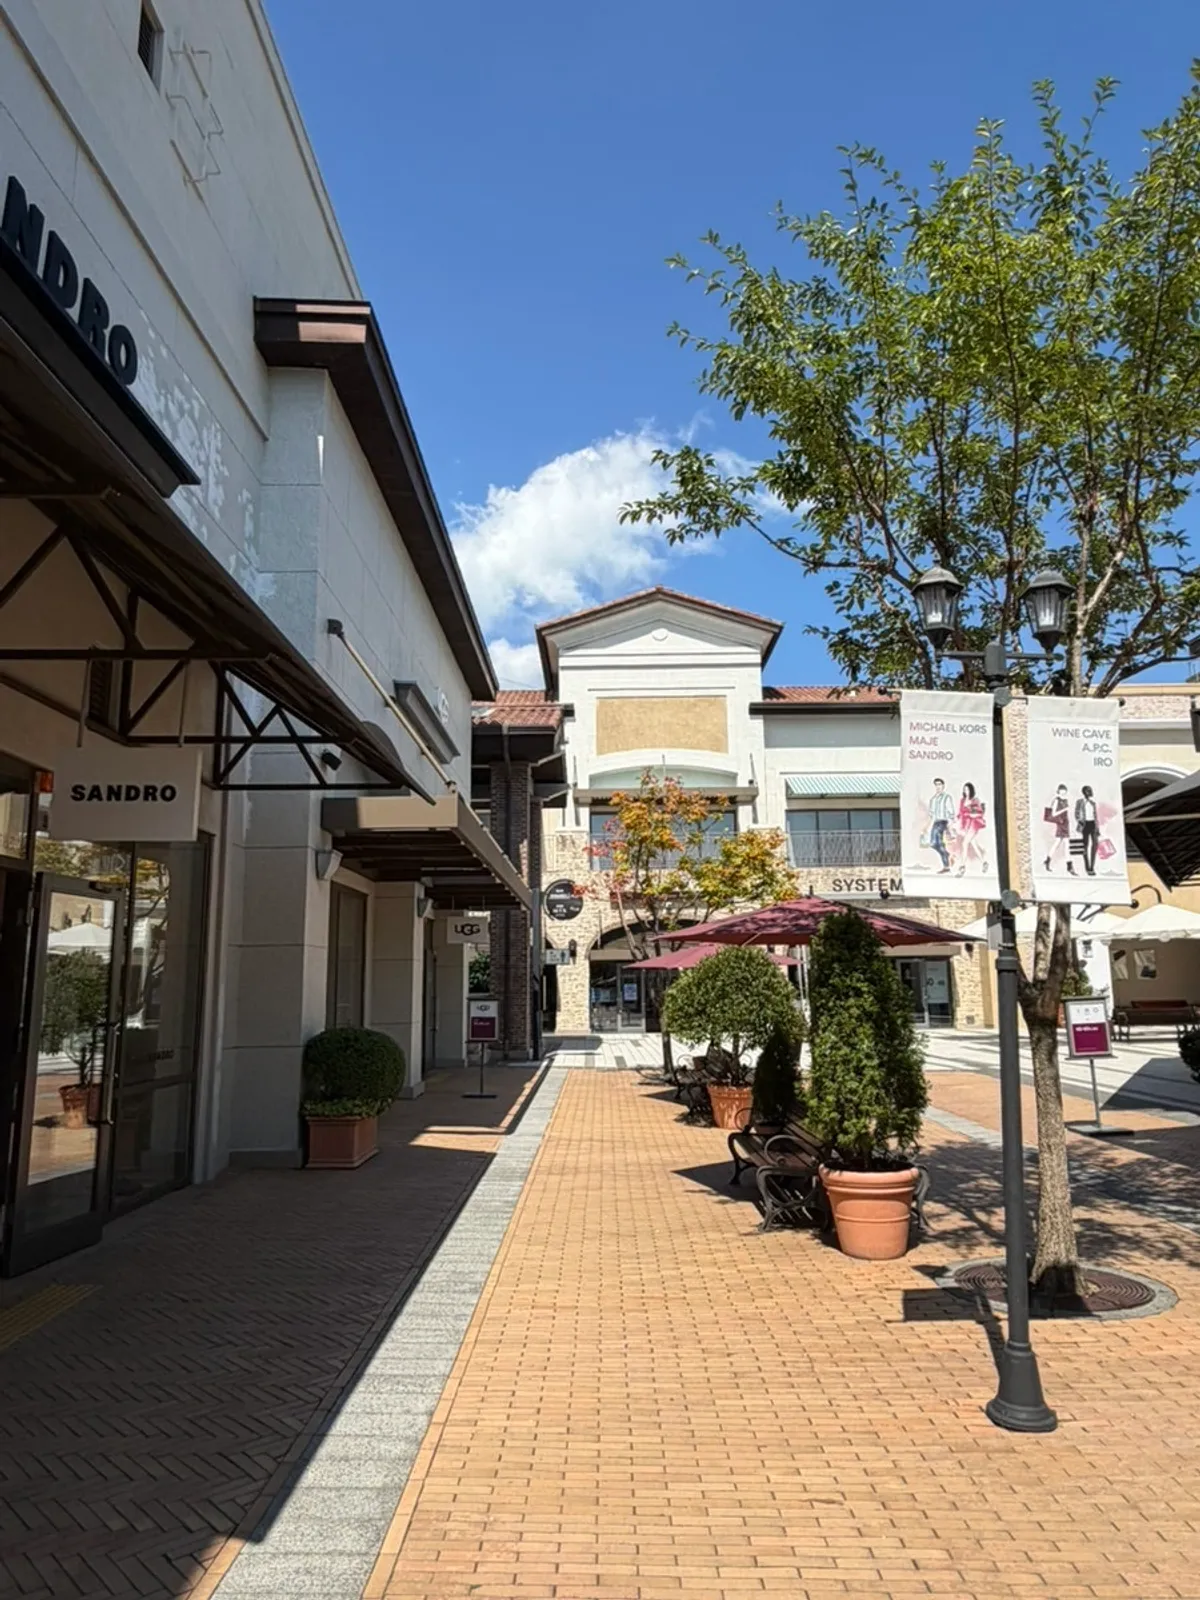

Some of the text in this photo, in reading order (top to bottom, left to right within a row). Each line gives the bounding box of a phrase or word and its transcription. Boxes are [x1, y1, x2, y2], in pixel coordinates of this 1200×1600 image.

[2, 175, 138, 385] NDRO
[909, 722, 987, 734] MICHAEL KORS
[1051, 727, 1112, 739] WINE CAVE
[909, 736, 939, 746] MAJE
[1082, 742, 1112, 753] A.P.C.
[908, 749, 954, 761] SANDRO
[1093, 756, 1113, 767] IRO
[70, 784, 177, 802] SANDRO
[832, 878, 904, 892] SYSTEM
[454, 923, 481, 936] UGG
